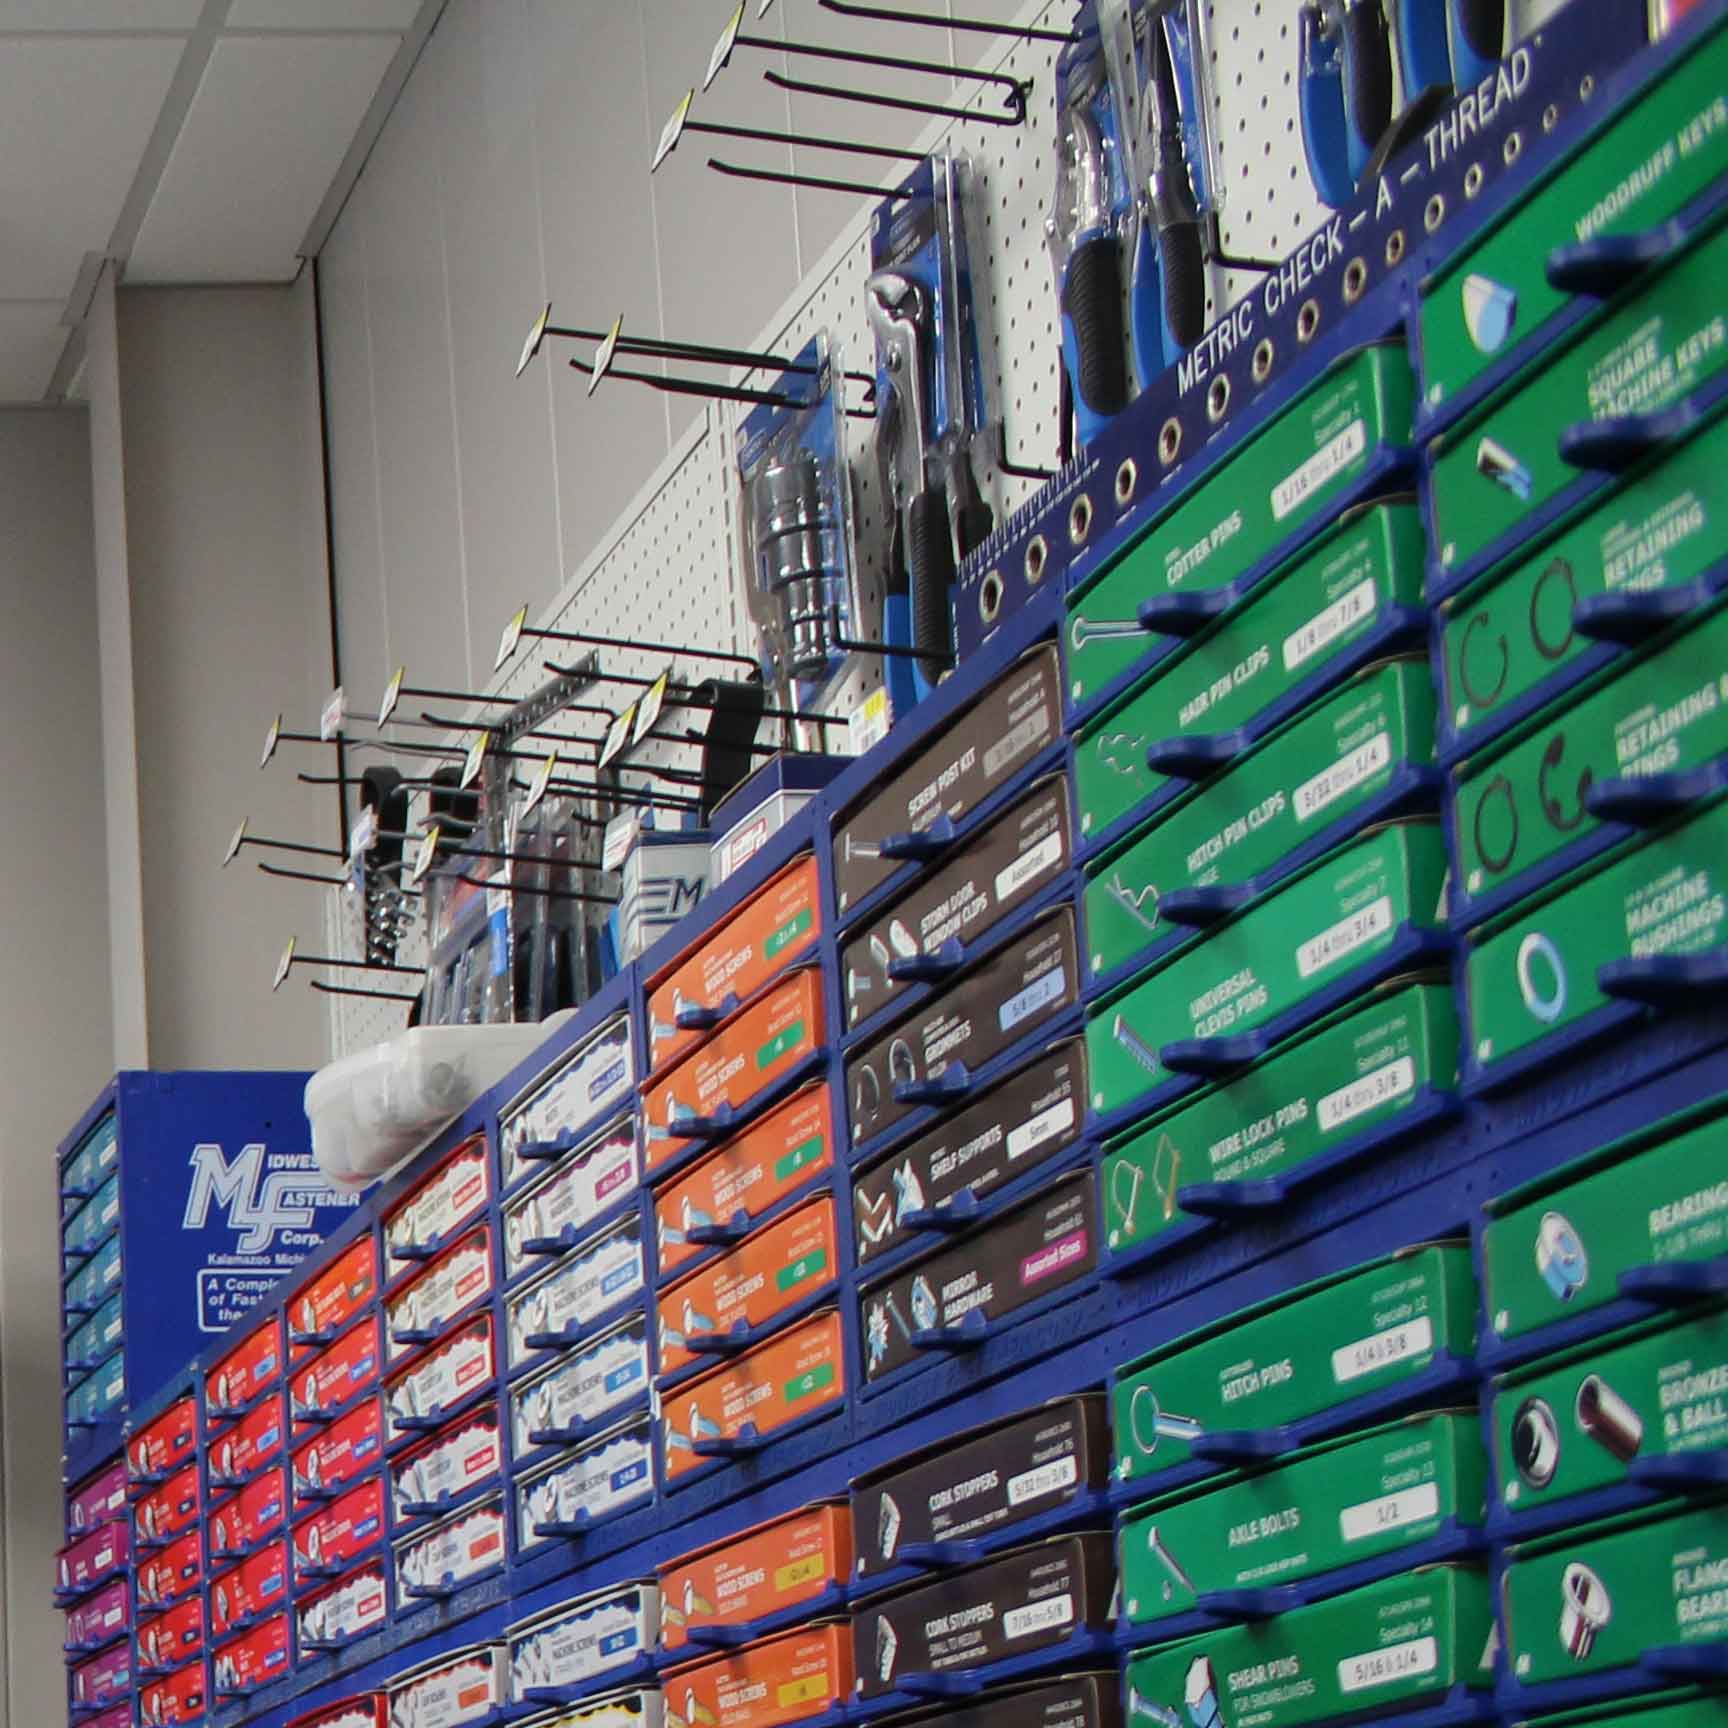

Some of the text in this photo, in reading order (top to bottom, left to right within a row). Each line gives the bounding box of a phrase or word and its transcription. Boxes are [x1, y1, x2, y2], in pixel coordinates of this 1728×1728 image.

[1573, 97, 1728, 245] WOODRUFF KEYS
[1176, 48, 1529, 398] METRIC CHECK THREAD
[1674, 315, 1726, 371] KEYS
[1588, 336, 1658, 407] SQUARE
[1166, 509, 1243, 588] COTTER PINS
[1605, 501, 1705, 586] RETAINING
[1615, 681, 1718, 763] RETAINING
[907, 781, 938, 818] SCREW
[283, 1192, 361, 1208] ASTENER
[207, 1253, 271, 1265] Kalamazoo
[280, 1230, 325, 1249] Corp.
[207, 1278, 218, 1290] A
[209, 1293, 225, 1306] of
[1221, 1359, 1294, 1403] HITCH PINS
[1260, 1507, 1301, 1539] BOLTS
[1227, 1654, 1300, 1693] SHEAR PINS
